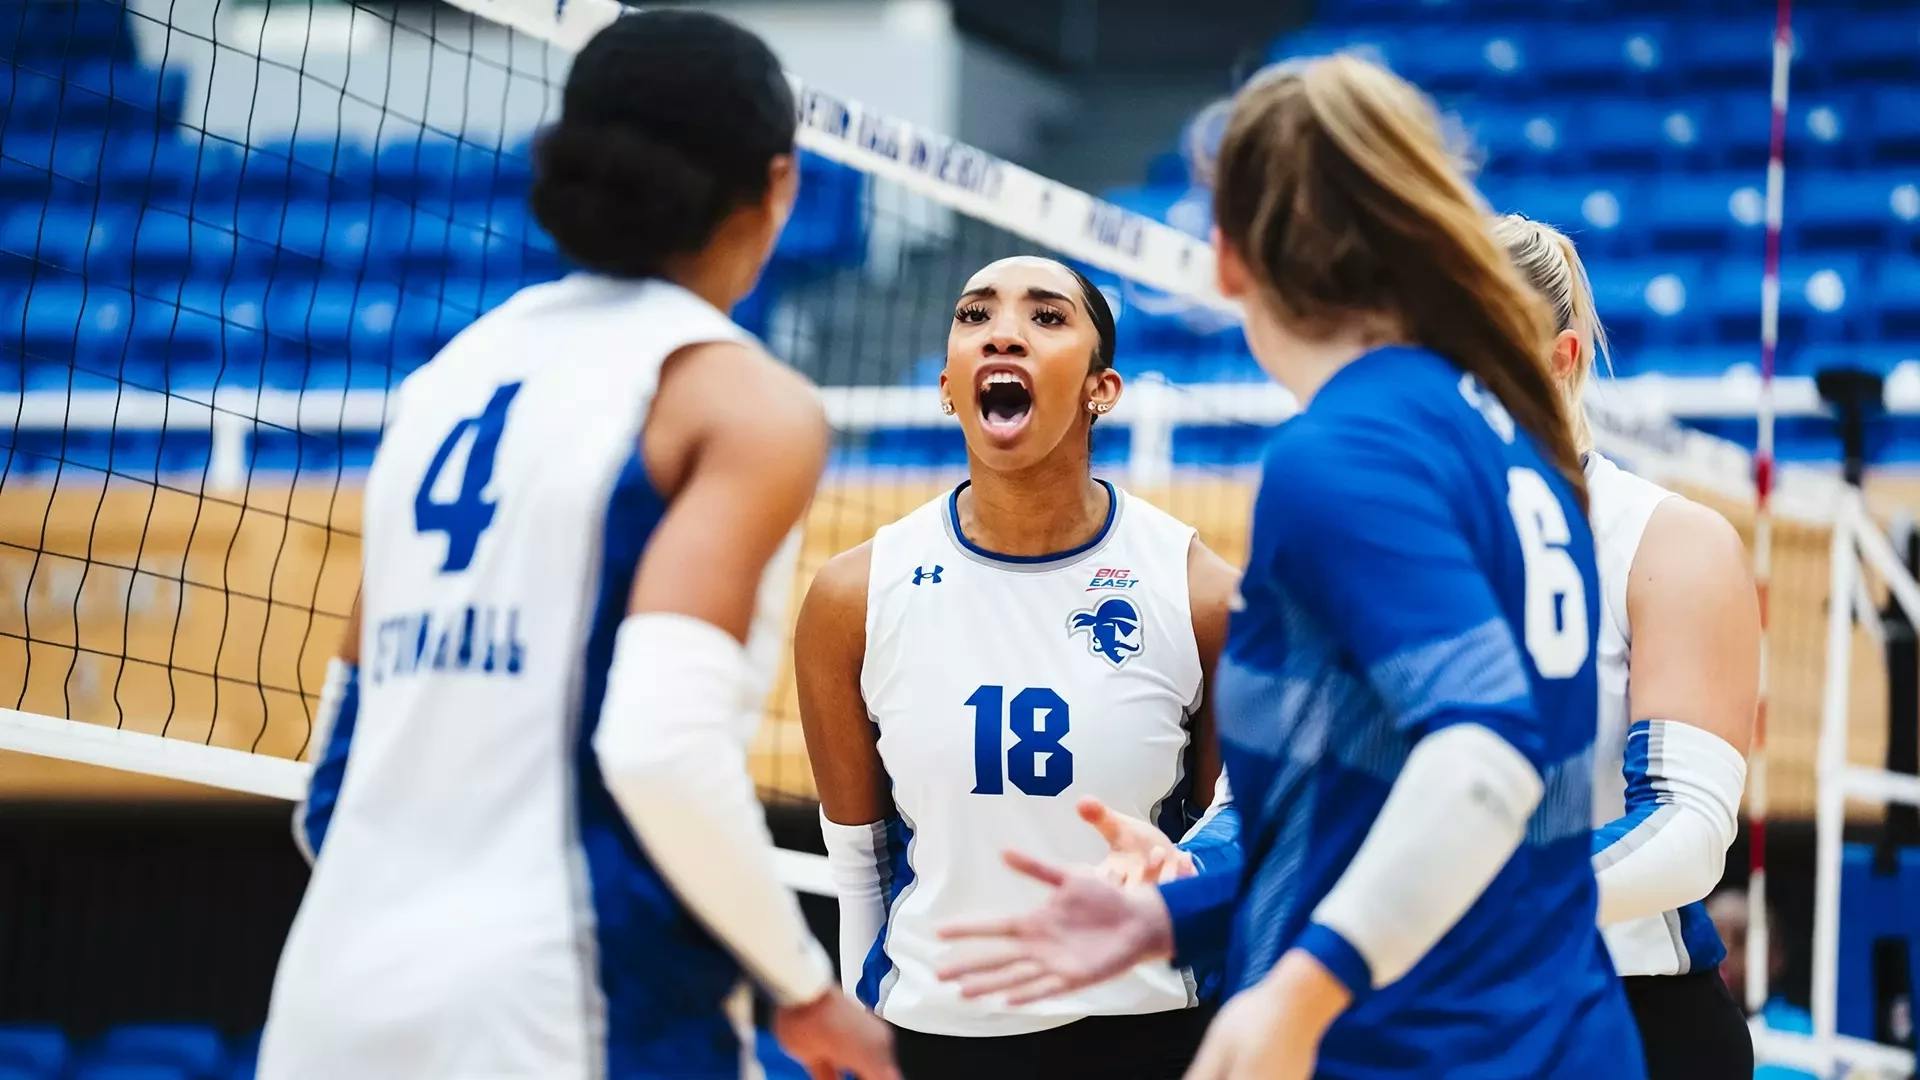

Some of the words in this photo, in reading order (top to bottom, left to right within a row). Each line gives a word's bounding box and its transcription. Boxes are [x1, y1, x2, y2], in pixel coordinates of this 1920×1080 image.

[415, 381, 523, 572] 4
[1089, 578, 1139, 588] EAST
[1094, 568, 1131, 579] BIG
[1507, 466, 1590, 679] 6
[963, 685, 1073, 797] 18
